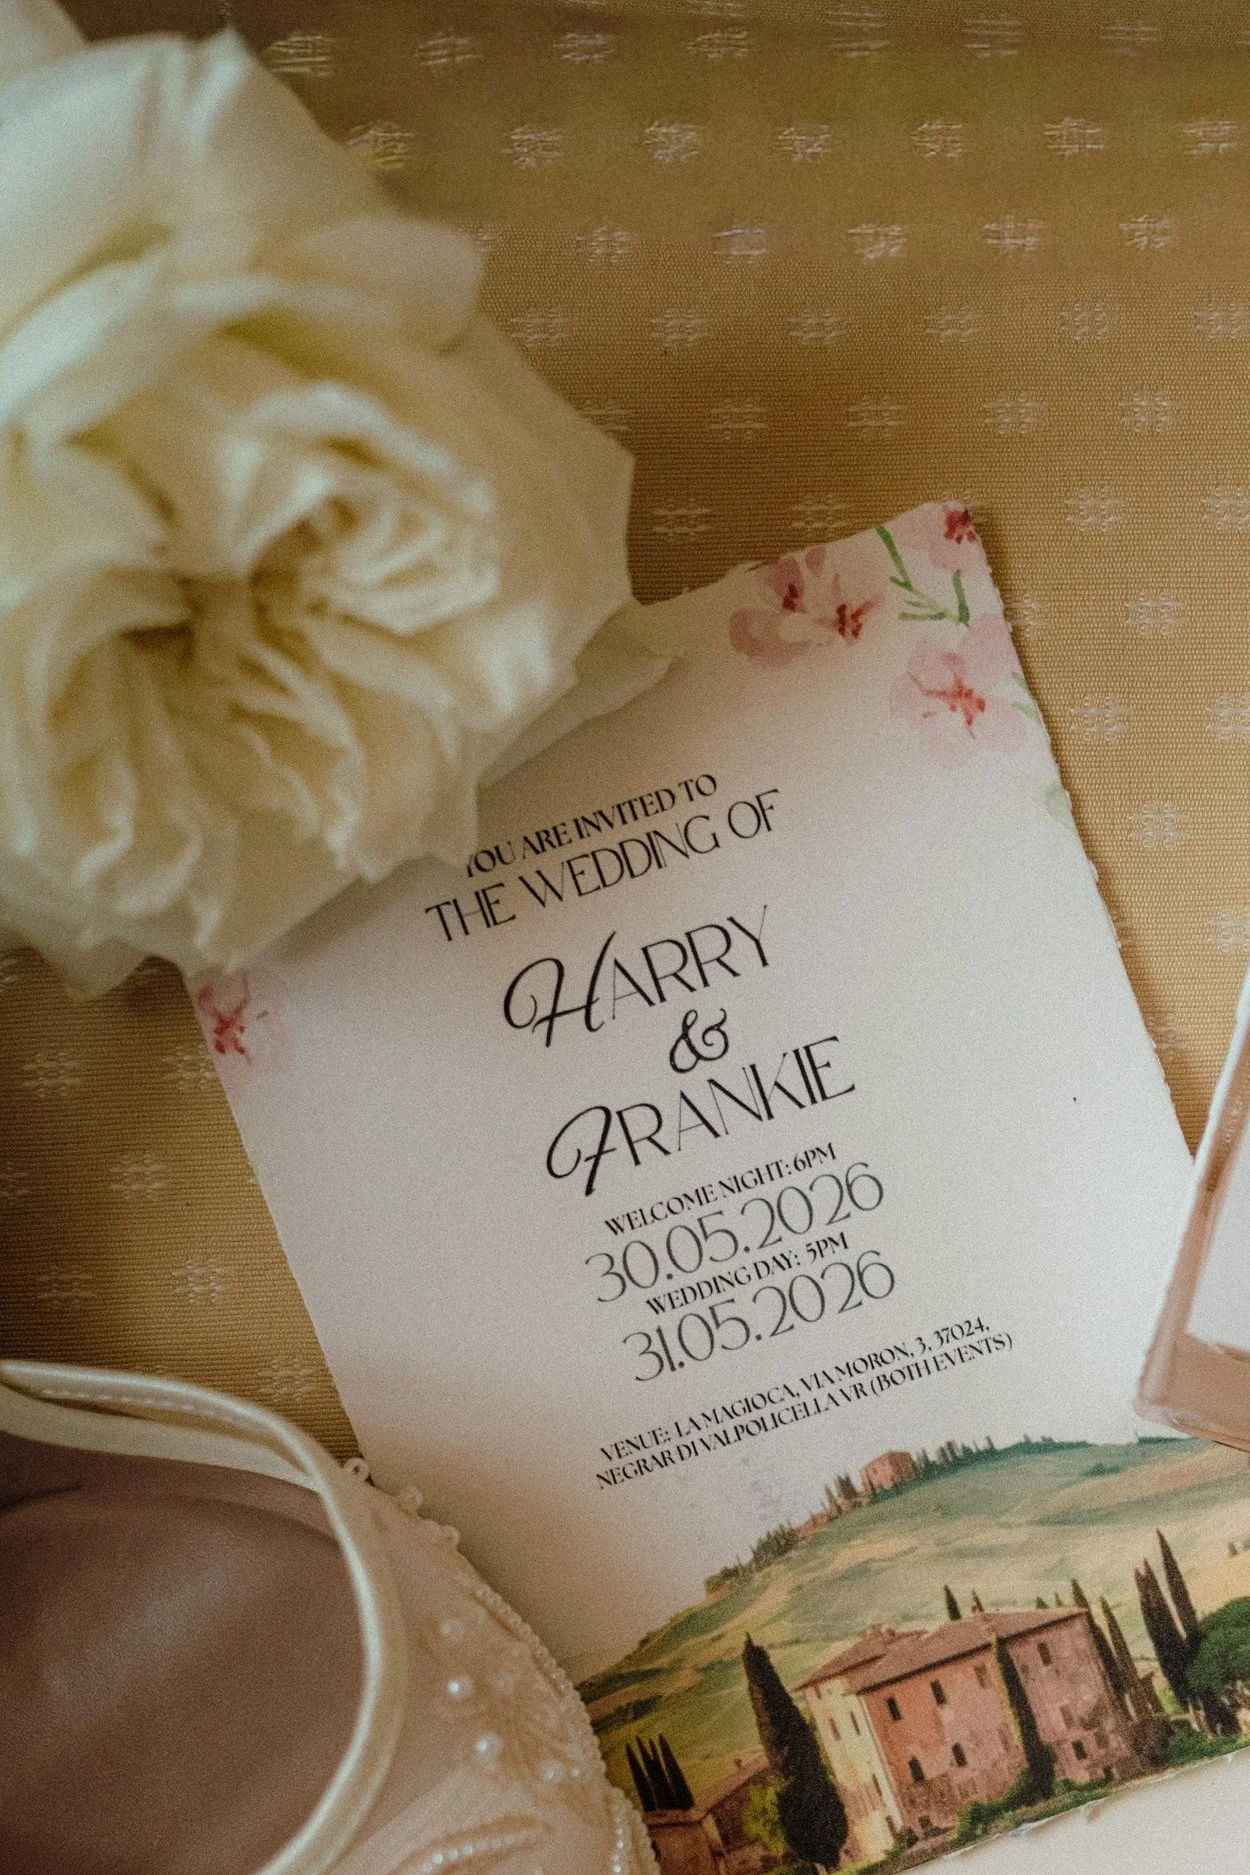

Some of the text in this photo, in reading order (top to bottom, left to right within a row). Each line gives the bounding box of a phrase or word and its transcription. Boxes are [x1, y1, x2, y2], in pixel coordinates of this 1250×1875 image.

[522, 823, 573, 860] ARE
[573, 788, 676, 840] INVITED
[678, 774, 718, 802] TO
[425, 789, 780, 942] THE WEDDING OF
[668, 1008, 730, 1074] &
[584, 1161, 884, 1303] 30.05.2026
[604, 1142, 837, 1237] WELCOME NIGHT: 6PM
[622, 1249, 896, 1382] 31.05.2026
[645, 1231, 849, 1316] WEDDING DAY: 5PM
[596, 1332, 1014, 1490] NEGRAR DI VALPOLICELLA VR (BOTH EVENTS)
[600, 1427, 672, 1462] VENUE:
[674, 1416, 702, 1438] LA
[800, 1369, 836, 1391] VIA
